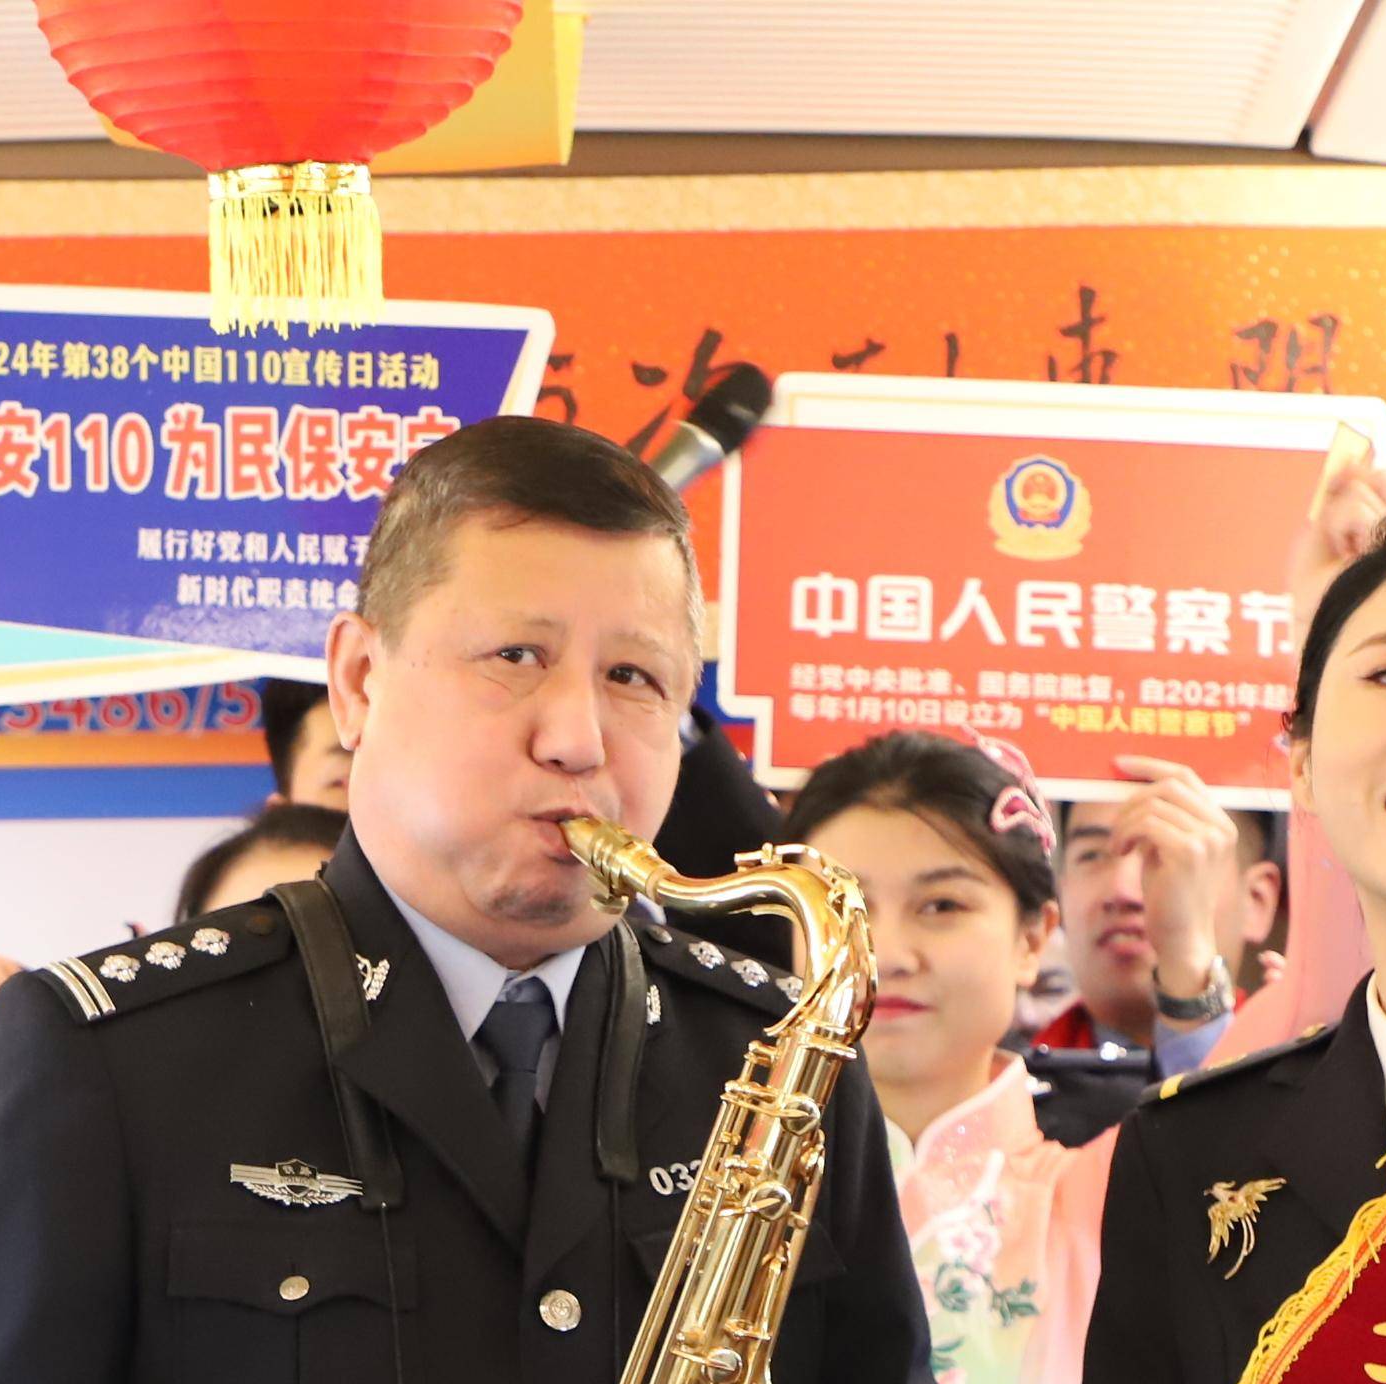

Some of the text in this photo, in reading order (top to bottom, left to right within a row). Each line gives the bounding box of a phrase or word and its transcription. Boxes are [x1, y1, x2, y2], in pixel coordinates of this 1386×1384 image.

[790, 572, 1294, 658] 中国人民警察节
[649, 1159, 702, 1196] 03
